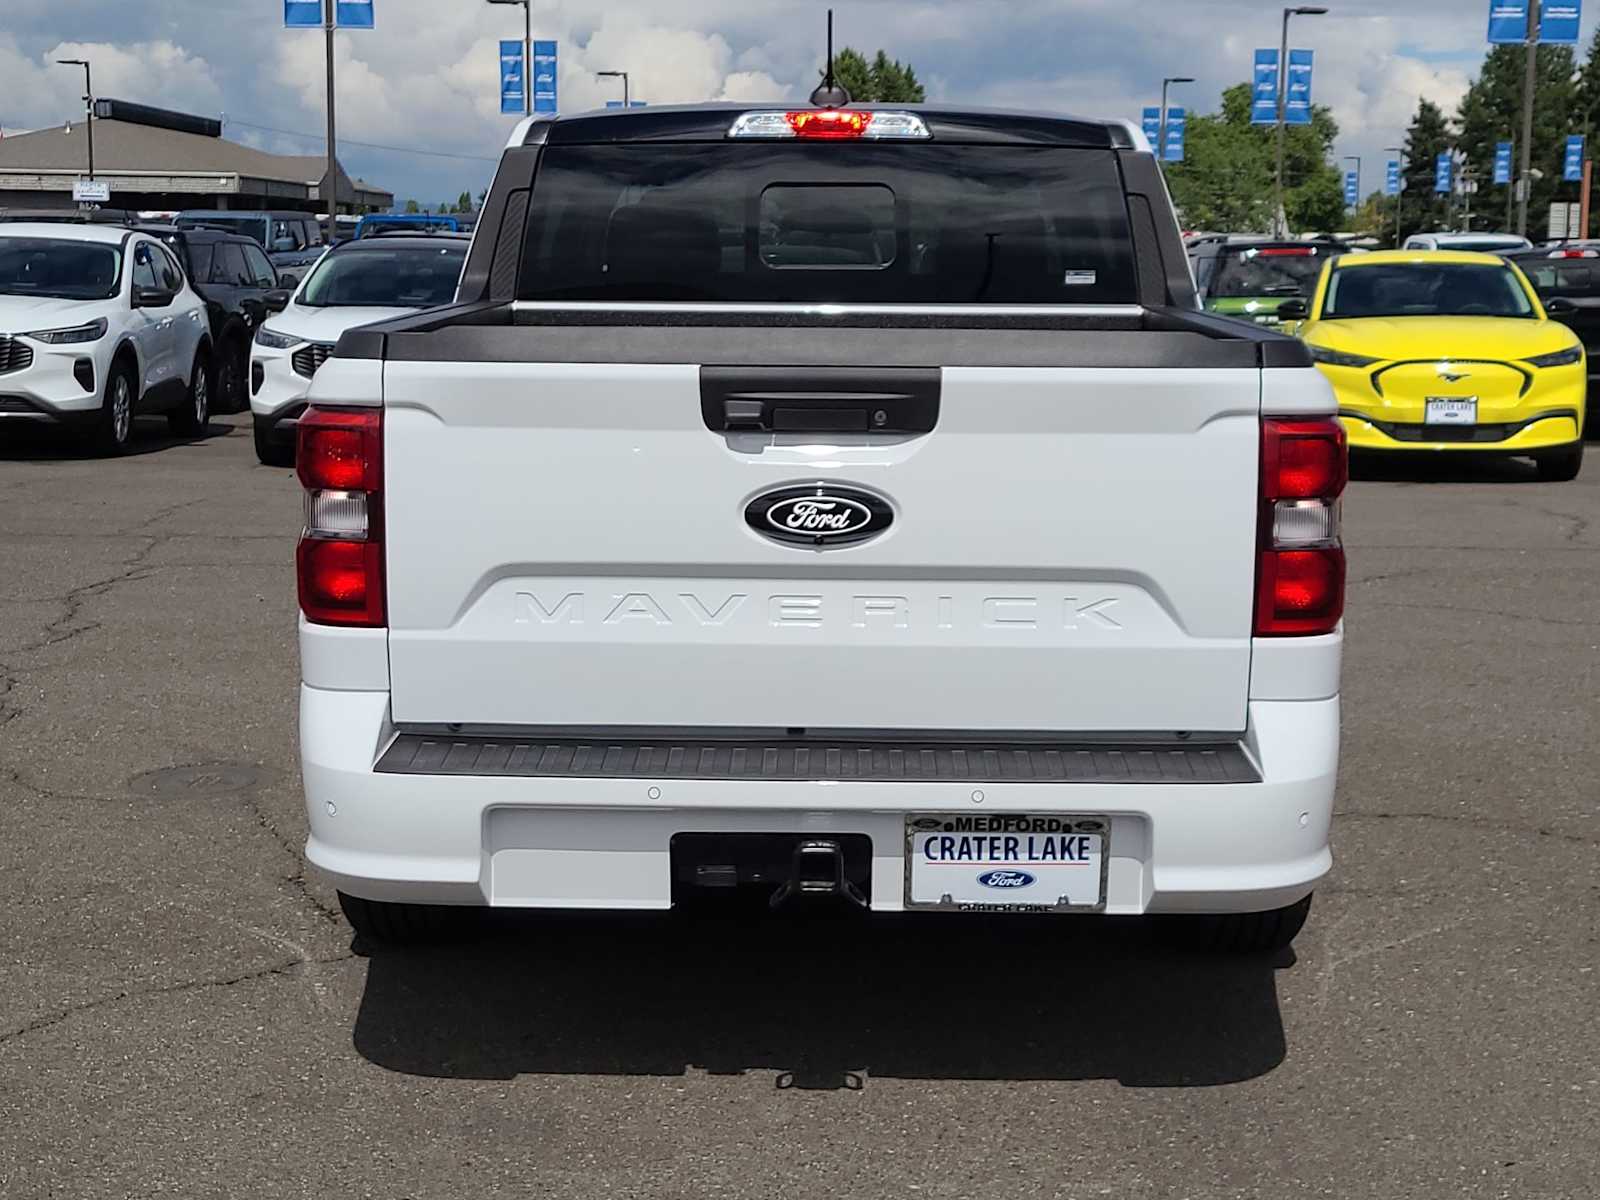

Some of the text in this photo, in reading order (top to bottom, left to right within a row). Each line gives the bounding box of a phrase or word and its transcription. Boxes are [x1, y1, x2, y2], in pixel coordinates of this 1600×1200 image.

[787, 501, 851, 529] Ford
[514, 591, 1124, 631] MAVERICK
[956, 817, 1061, 833] MEDFORD
[924, 836, 1090, 862] CRATER LAKE
[987, 872, 1025, 887] Ford
